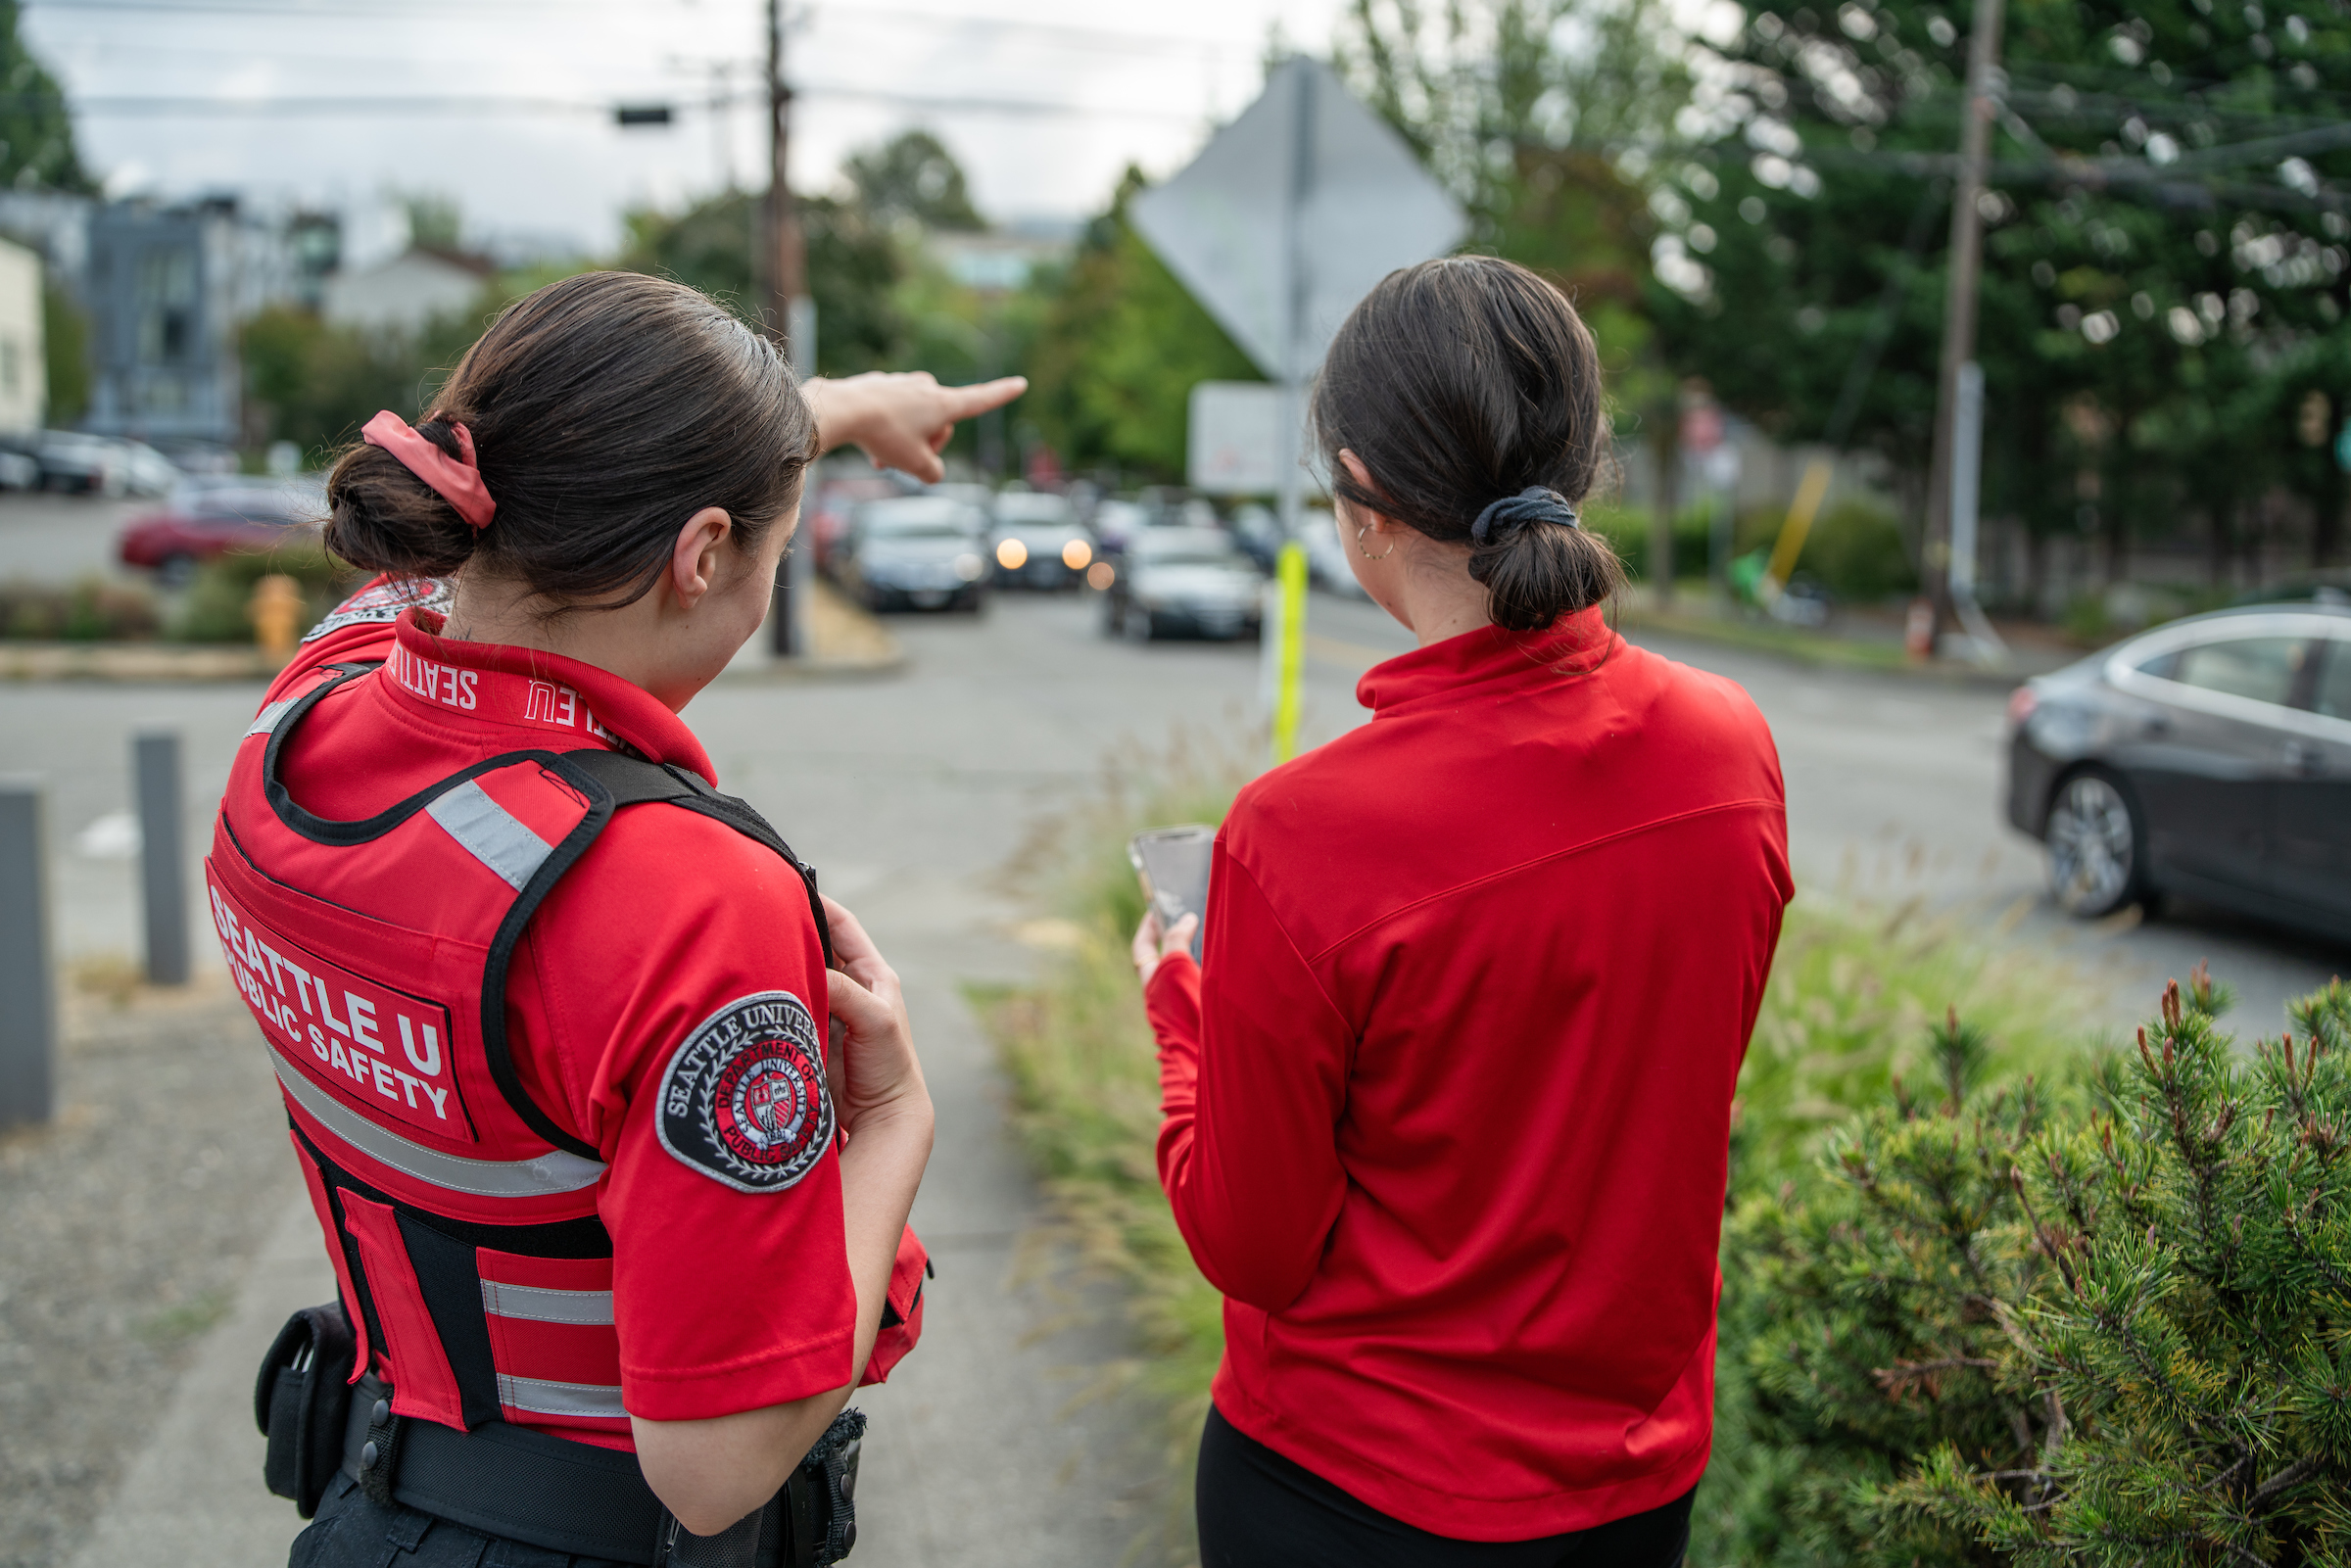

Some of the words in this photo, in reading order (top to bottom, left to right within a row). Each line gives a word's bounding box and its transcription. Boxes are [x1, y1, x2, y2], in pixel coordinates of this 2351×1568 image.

[210, 884, 386, 1055] SEATTLE
[397, 1013, 442, 1077] U
[308, 1023, 449, 1120] SAFETY
[667, 1015, 743, 1118] SEATTLE
[718, 1042, 801, 1109] DEPARTMENT
[801, 1063, 816, 1085] OF
[761, 1059, 806, 1119] UNIVERSITY
[724, 1125, 775, 1163] PUBLIC
[780, 1103, 819, 1160] SAFETY
